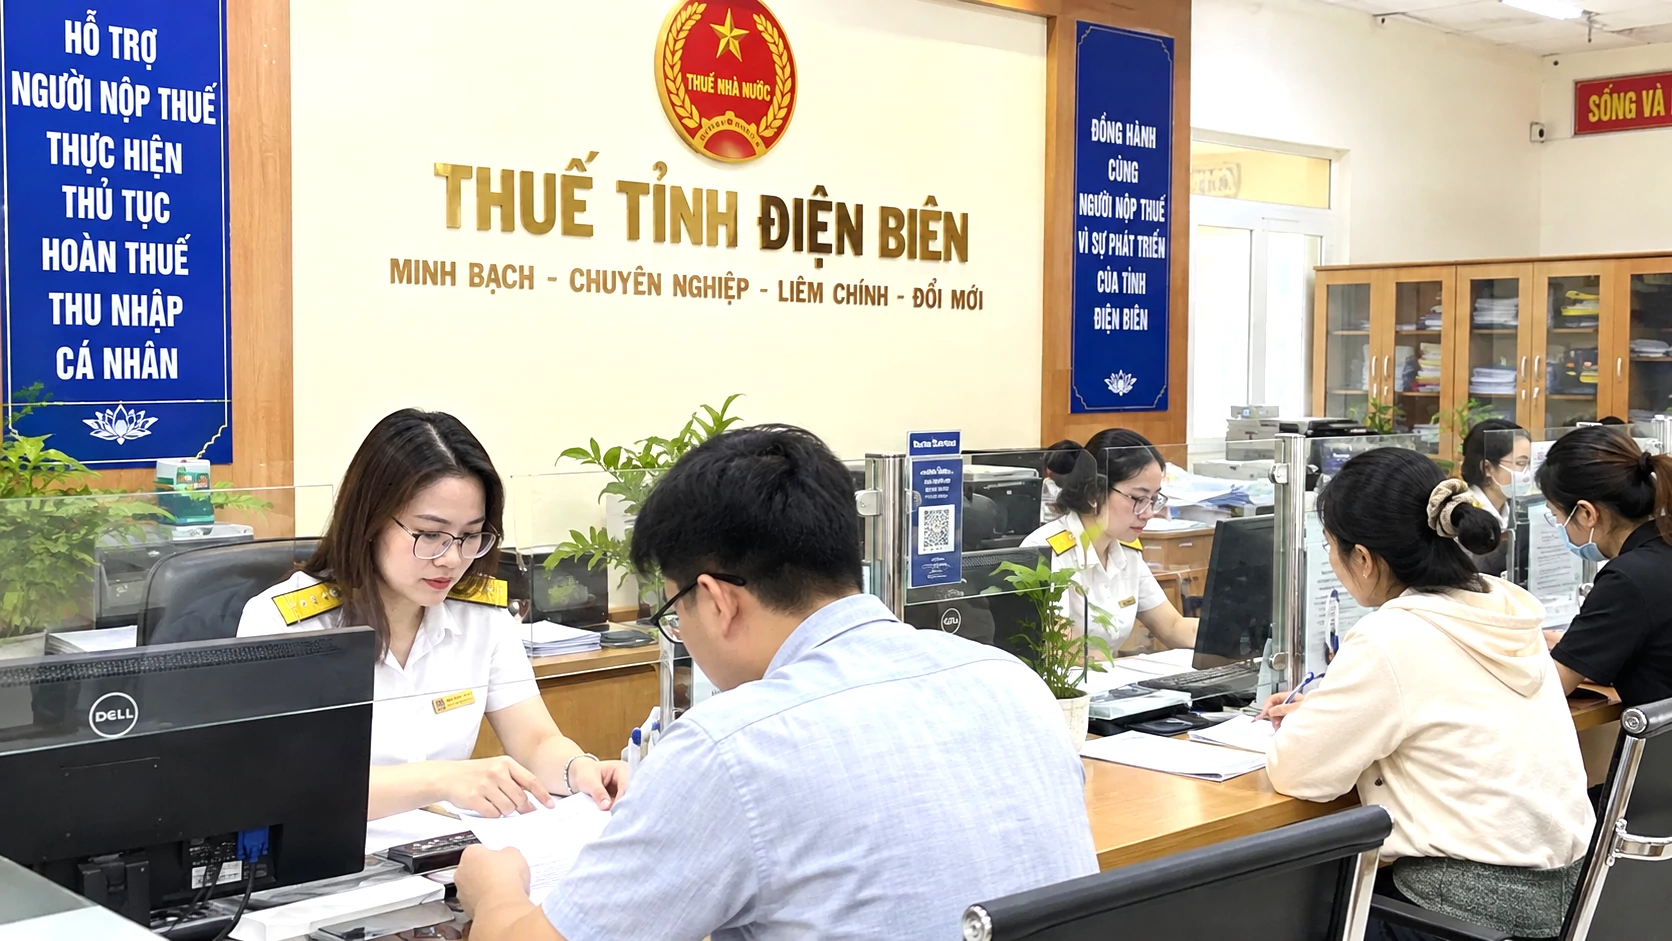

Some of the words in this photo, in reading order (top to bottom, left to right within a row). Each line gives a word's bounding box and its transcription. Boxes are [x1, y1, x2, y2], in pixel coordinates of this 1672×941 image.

[64, 9, 100, 56] HỖ
[108, 25, 158, 71] TRỢ
[11, 68, 92, 113] NGƯỜI
[99, 76, 151, 123] NỘP
[157, 82, 218, 125] THUẾ
[686, 71, 715, 93] THUẾ
[717, 75, 739, 97] NHÀ
[1588, 83, 1636, 123] SỐNG
[1641, 82, 1665, 118] VÀ
[1090, 111, 1123, 145] ĐỒNG
[1125, 119, 1157, 149] HÀNH
[46, 130, 115, 175] THỰC
[123, 134, 183, 180] HIỆN
[1108, 154, 1139, 184] CÙNG
[61, 177, 113, 221] THỦ
[121, 189, 171, 230] TỤC
[434, 150, 600, 237] THUẾ
[616, 160, 738, 248] TỈNH
[757, 184, 863, 269] ĐIỆN
[878, 195, 968, 263] BIÊN
[1079, 189, 1113, 218] NGƯỜI
[1115, 192, 1138, 224] NỘP
[1139, 194, 1167, 223] THUẾ
[41, 232, 117, 273] HOÀN
[124, 233, 191, 276] THUẾ
[1078, 225, 1089, 254] VÌ
[1091, 230, 1108, 260] SỰ
[1108, 229, 1135, 257] PHÁT
[390, 258, 456, 286] MINH
[469, 262, 534, 295] BẠCH
[569, 265, 662, 296] CHUYÊN
[672, 271, 750, 305] NGHIỆP
[778, 275, 824, 304] LIÊM
[832, 279, 888, 306] CHÍNH
[912, 278, 942, 309] ĐỔI
[951, 284, 983, 310] MỚI
[48, 292, 102, 326] THU
[111, 288, 184, 334] NHẬP
[1093, 302, 1120, 335] ĐIỆN
[1122, 303, 1148, 331] BIÊN
[56, 339, 95, 380] CÁ
[103, 340, 178, 380] NHÂN
[95, 708, 134, 723] DELL
